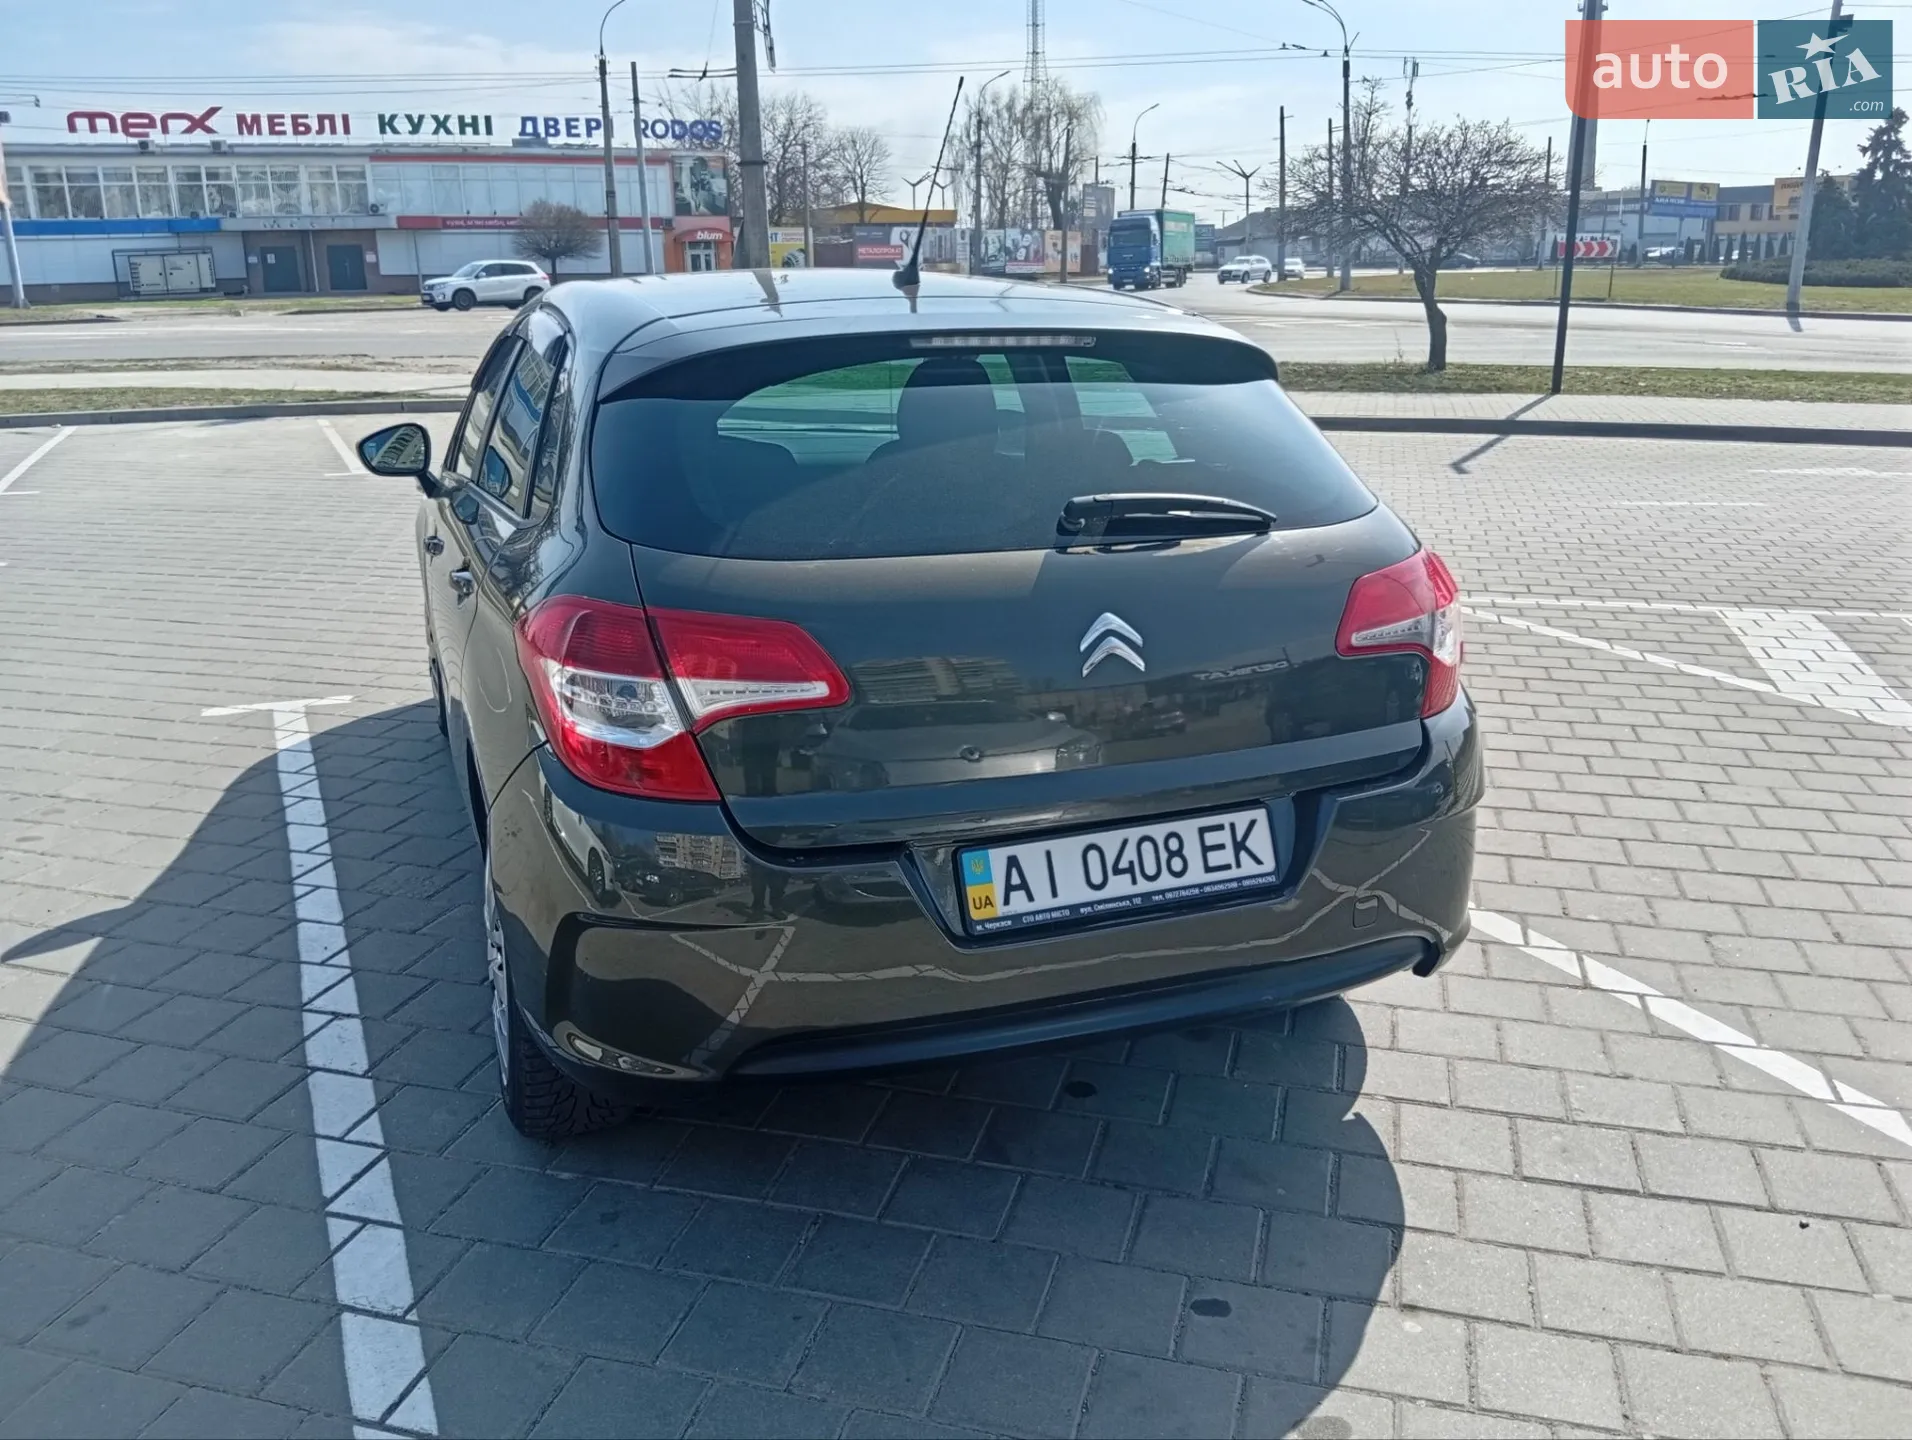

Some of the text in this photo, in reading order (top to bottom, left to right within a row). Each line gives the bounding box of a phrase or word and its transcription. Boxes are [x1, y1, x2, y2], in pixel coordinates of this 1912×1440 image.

[67, 106, 223, 138] merx
[236, 113, 351, 136] МЕБЛІ
[377, 113, 493, 136] КУХНІ
[696, 230, 723, 240] blum
[1003, 818, 1265, 907] AI 0408 EK
[972, 894, 995, 912] UA
[1022, 914, 1035, 924] СТО
[1035, 911, 1051, 922] АВТО
[1051, 908, 1070, 919] МІСТО
